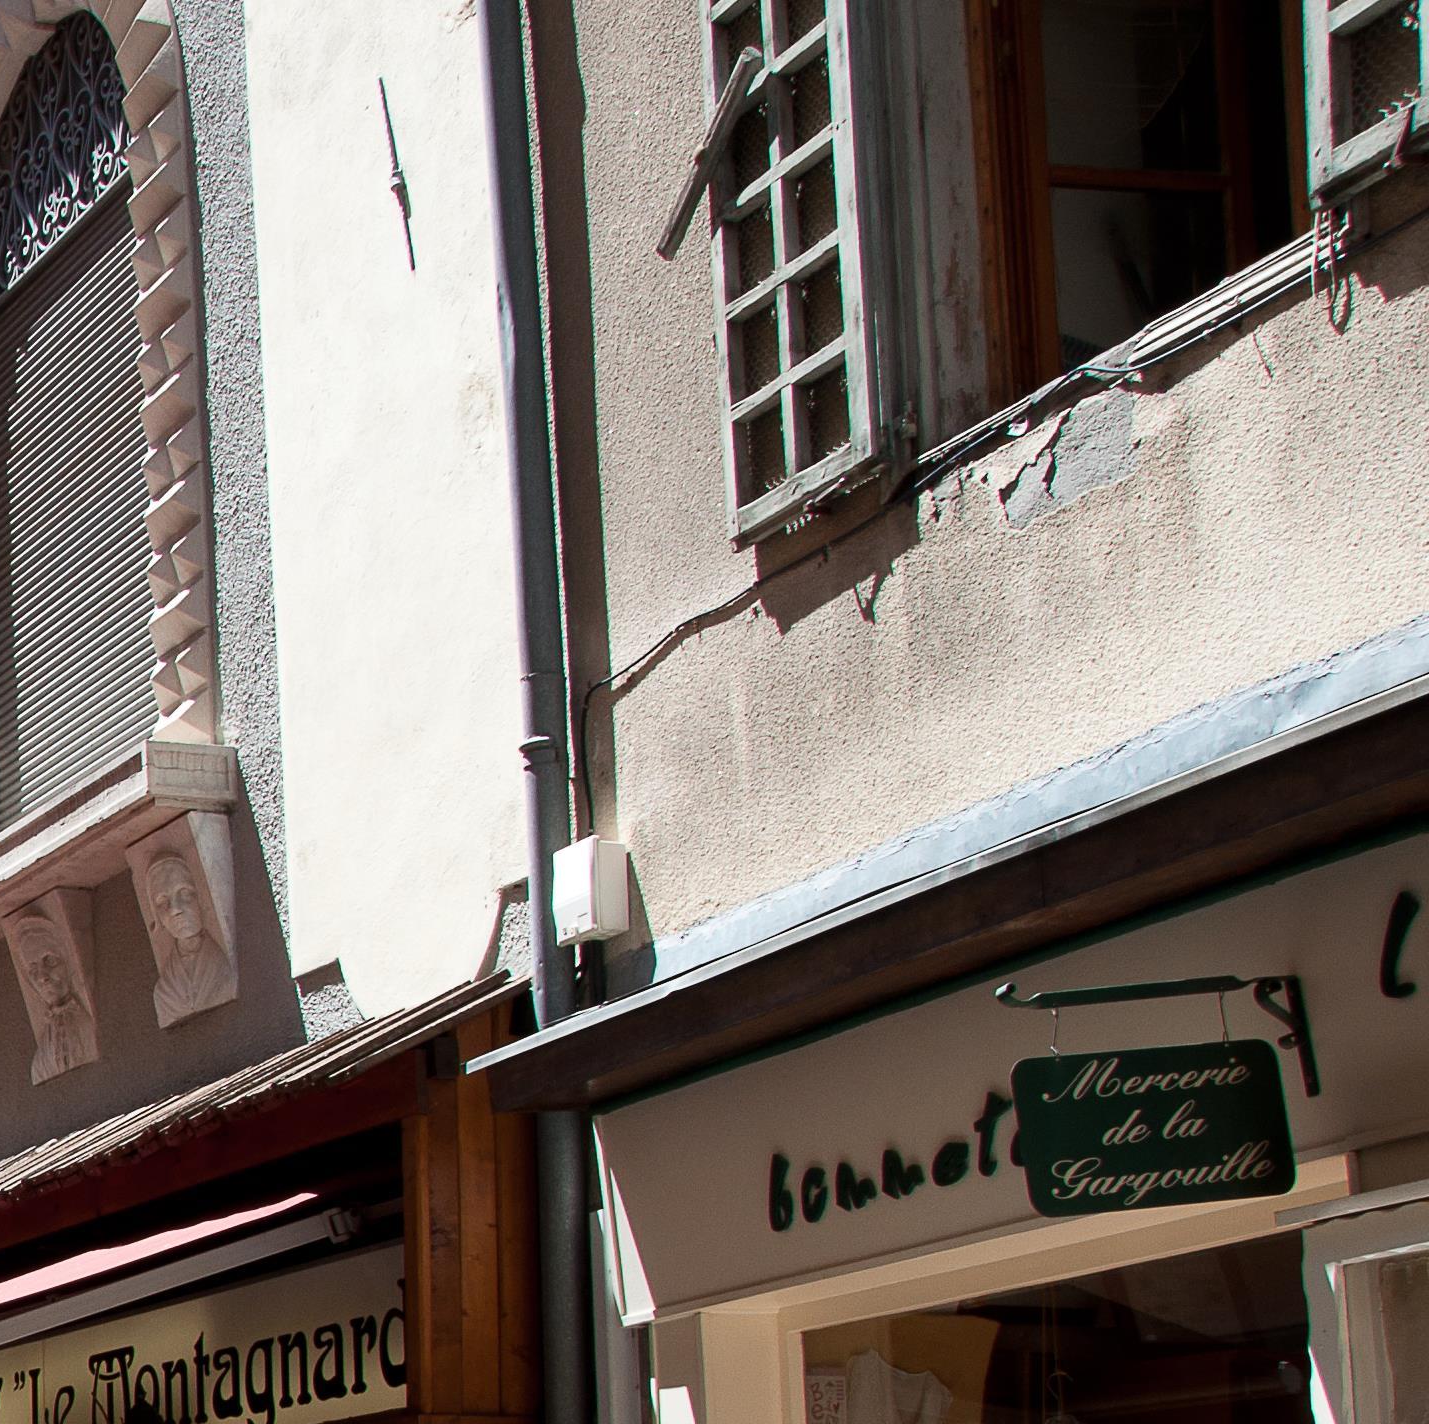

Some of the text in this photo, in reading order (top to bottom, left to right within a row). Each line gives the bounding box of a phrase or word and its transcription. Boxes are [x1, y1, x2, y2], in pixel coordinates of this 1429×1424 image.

[1042, 1056, 1250, 1102] Mercerie
[1102, 1100, 1207, 1147] de la
[1050, 1138, 1275, 1206] Gargouille
